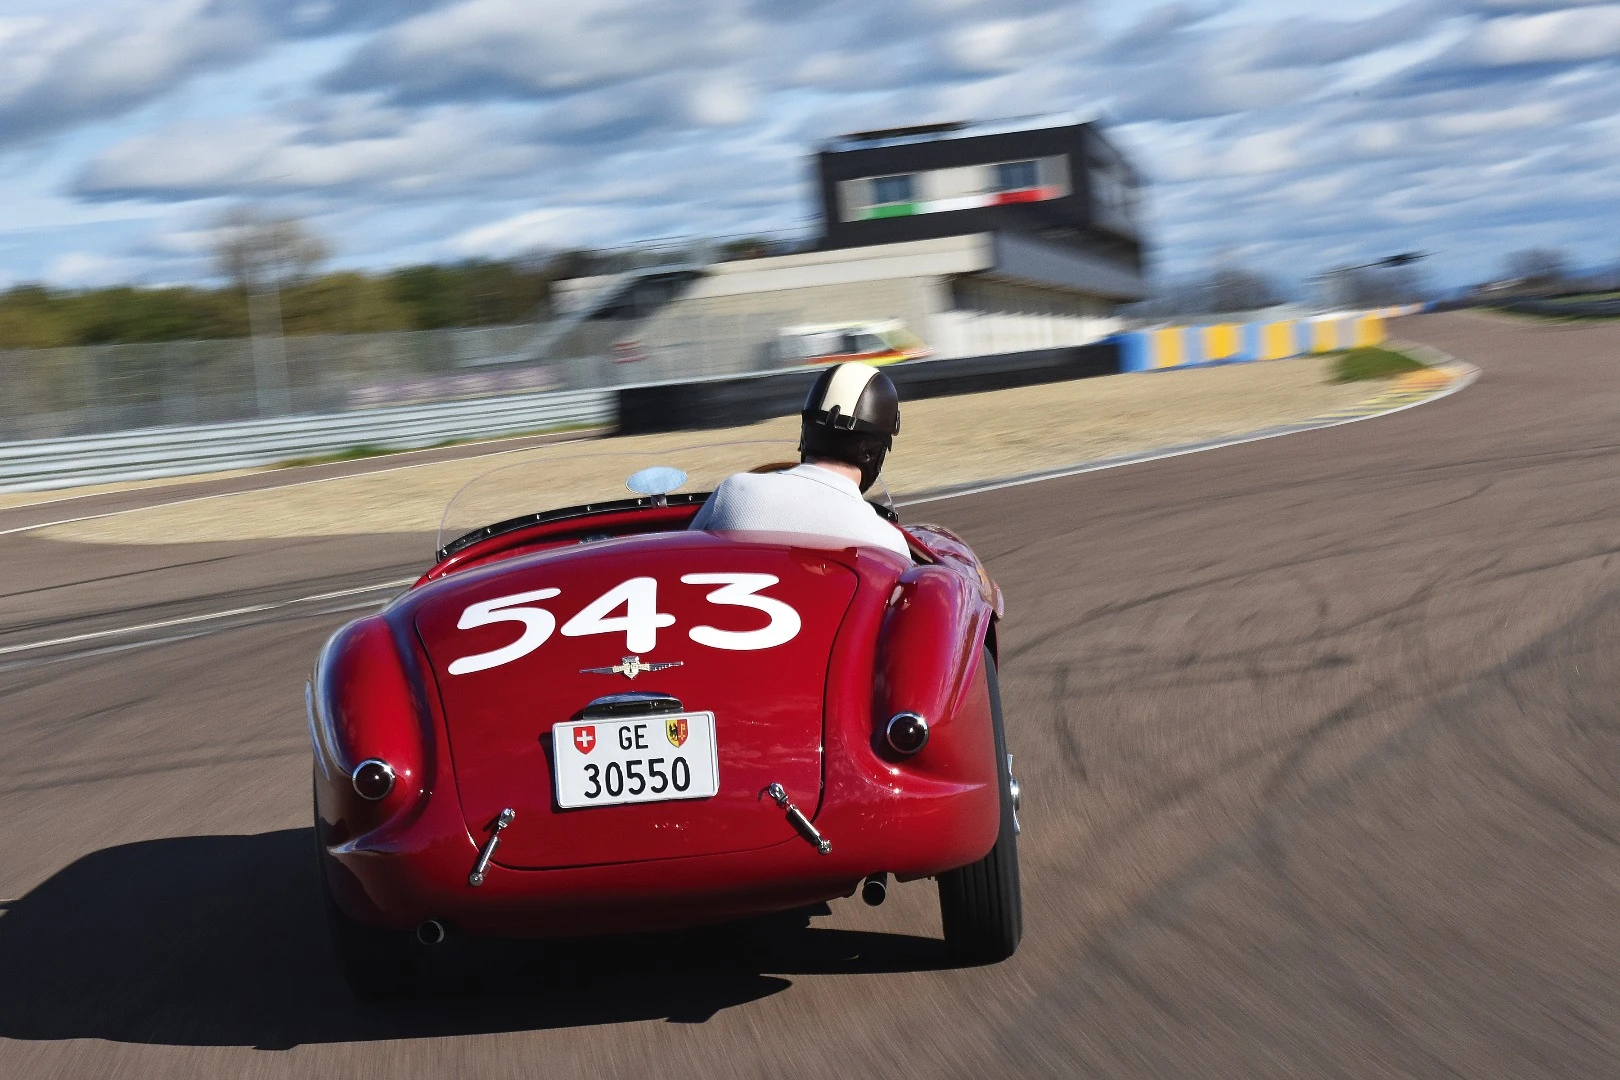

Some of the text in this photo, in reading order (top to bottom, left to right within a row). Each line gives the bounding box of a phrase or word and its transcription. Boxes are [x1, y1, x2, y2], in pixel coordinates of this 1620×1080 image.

[448, 573, 801, 675] 543
[619, 724, 648, 750] GE
[584, 757, 690, 798] 30550
